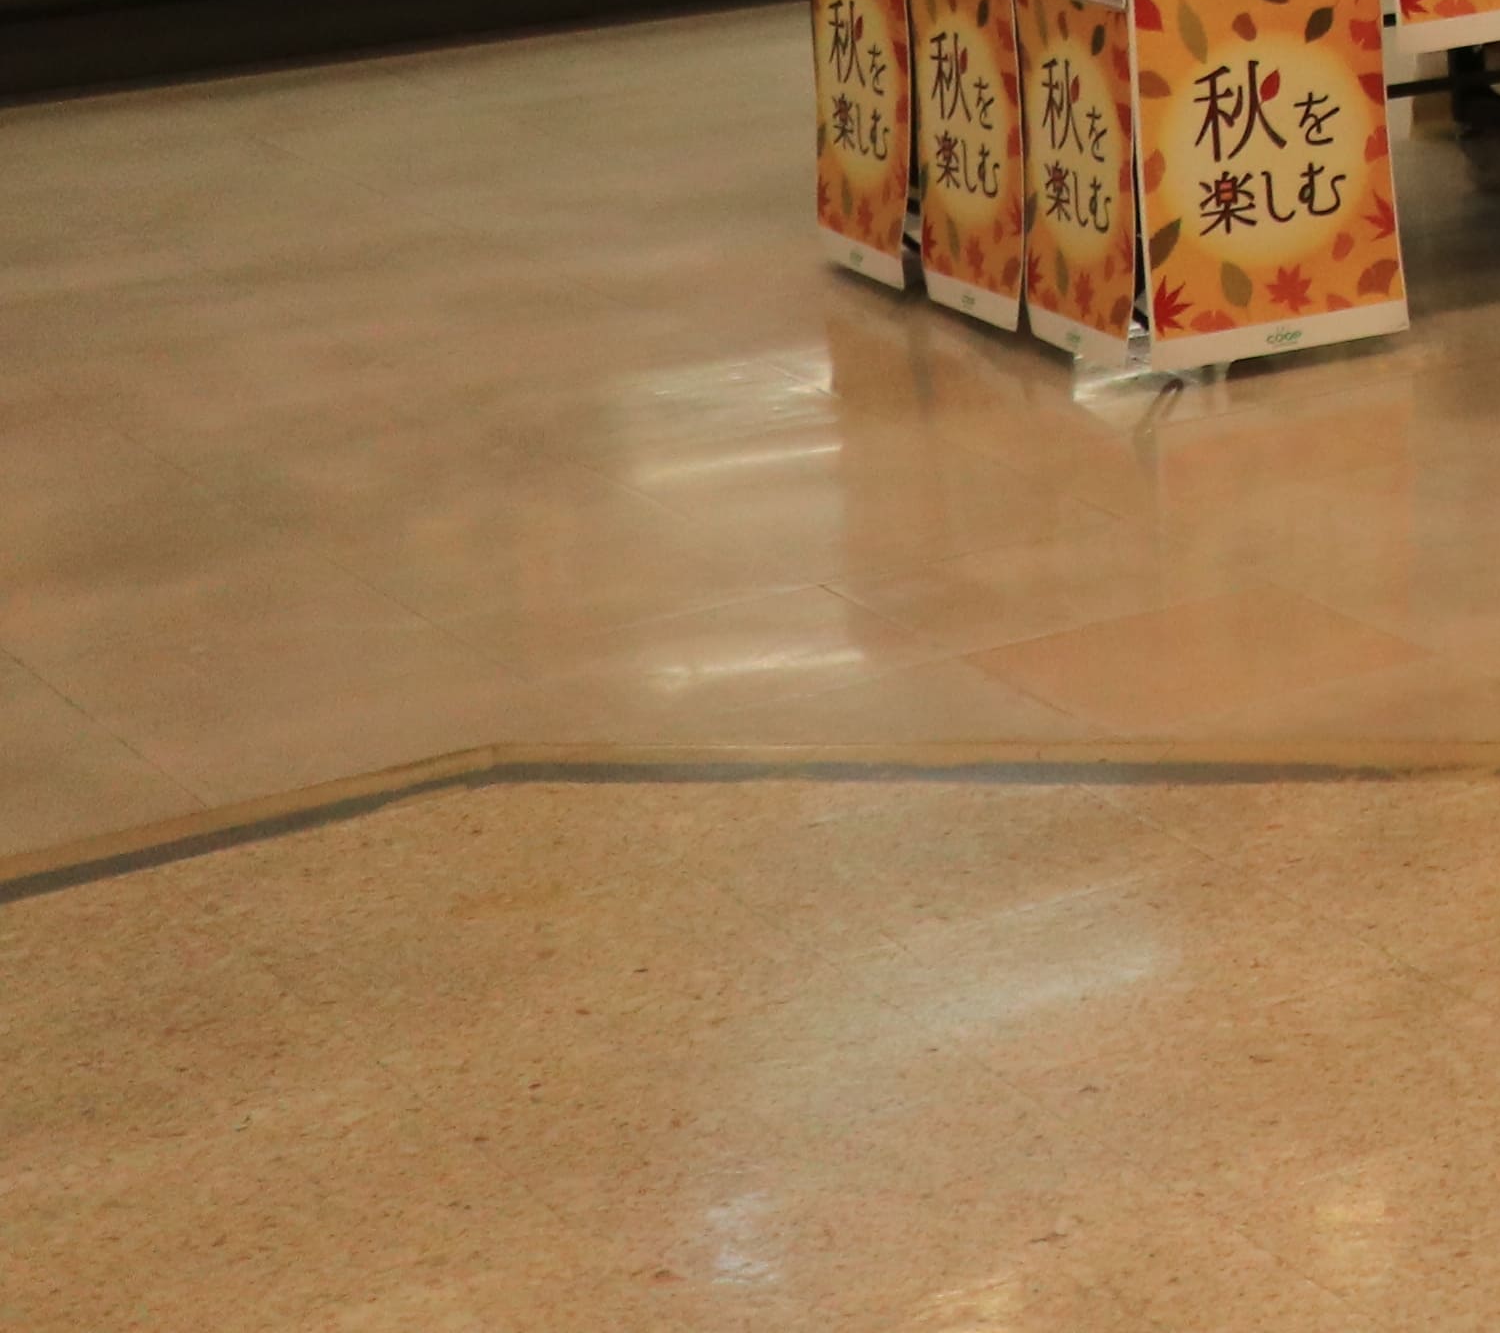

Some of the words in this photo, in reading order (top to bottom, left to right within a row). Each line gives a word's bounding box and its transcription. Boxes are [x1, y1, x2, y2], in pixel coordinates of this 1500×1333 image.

[1195, 61, 1340, 162] 秋を
[1200, 163, 1346, 237] 楽しむ
